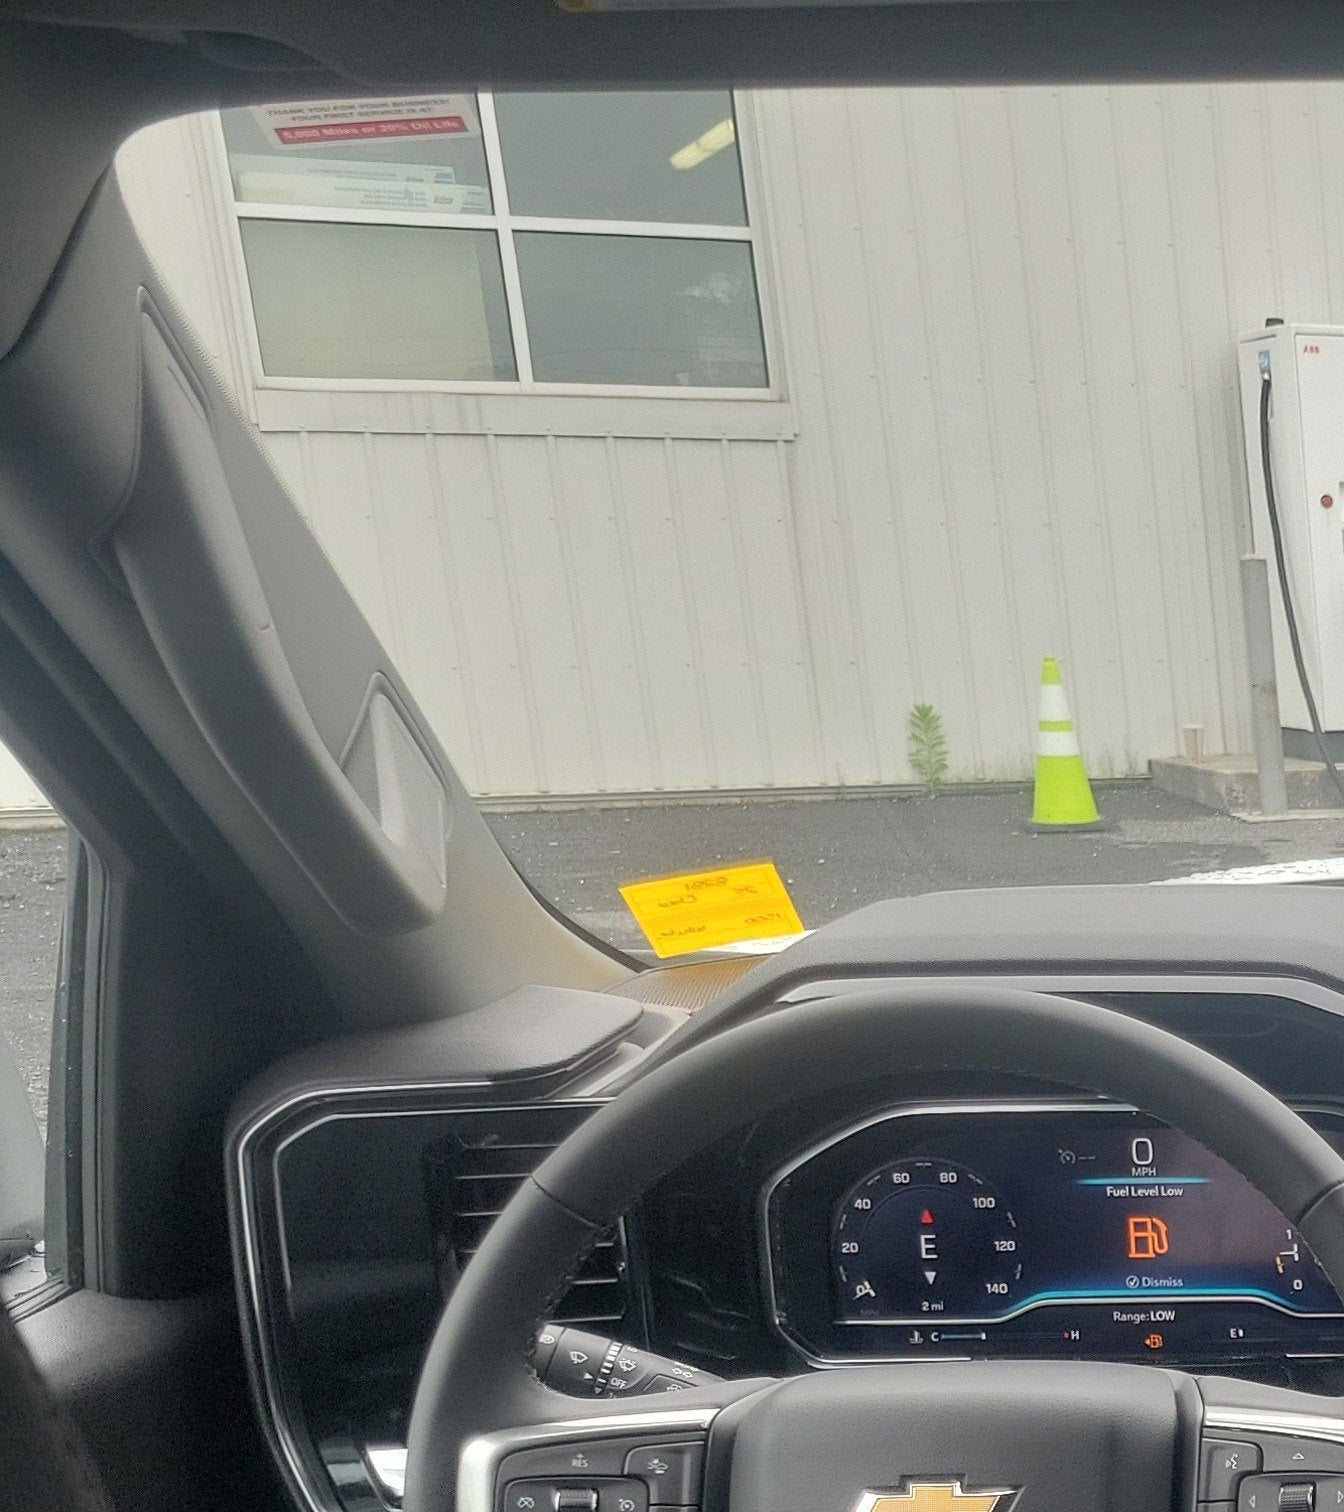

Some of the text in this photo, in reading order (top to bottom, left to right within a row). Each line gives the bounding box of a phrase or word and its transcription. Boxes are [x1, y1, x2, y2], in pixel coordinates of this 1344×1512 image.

[323, 126, 359, 137] Miles
[1132, 1137, 1154, 1165] 0
[892, 1172, 911, 1184] 60
[939, 1172, 958, 1184] 80
[1131, 1167, 1157, 1177] MPH
[1106, 1186, 1184, 1197] Fuel Level Low
[854, 1199, 872, 1209] 40
[972, 1197, 996, 1209] 100
[1286, 1229, 1293, 1240] 1
[841, 1242, 859, 1254] 20
[920, 1234, 938, 1259] E
[994, 1240, 1016, 1252] 120
[1142, 1276, 1184, 1288] Dismiss
[1293, 1279, 1303, 1291] 0
[986, 1283, 1008, 1294] 140
[931, 1301, 944, 1312] mi
[1113, 1310, 1176, 1323] Range: LOW
[1071, 1330, 1080, 1340] H
[1230, 1328, 1237, 1339] E
